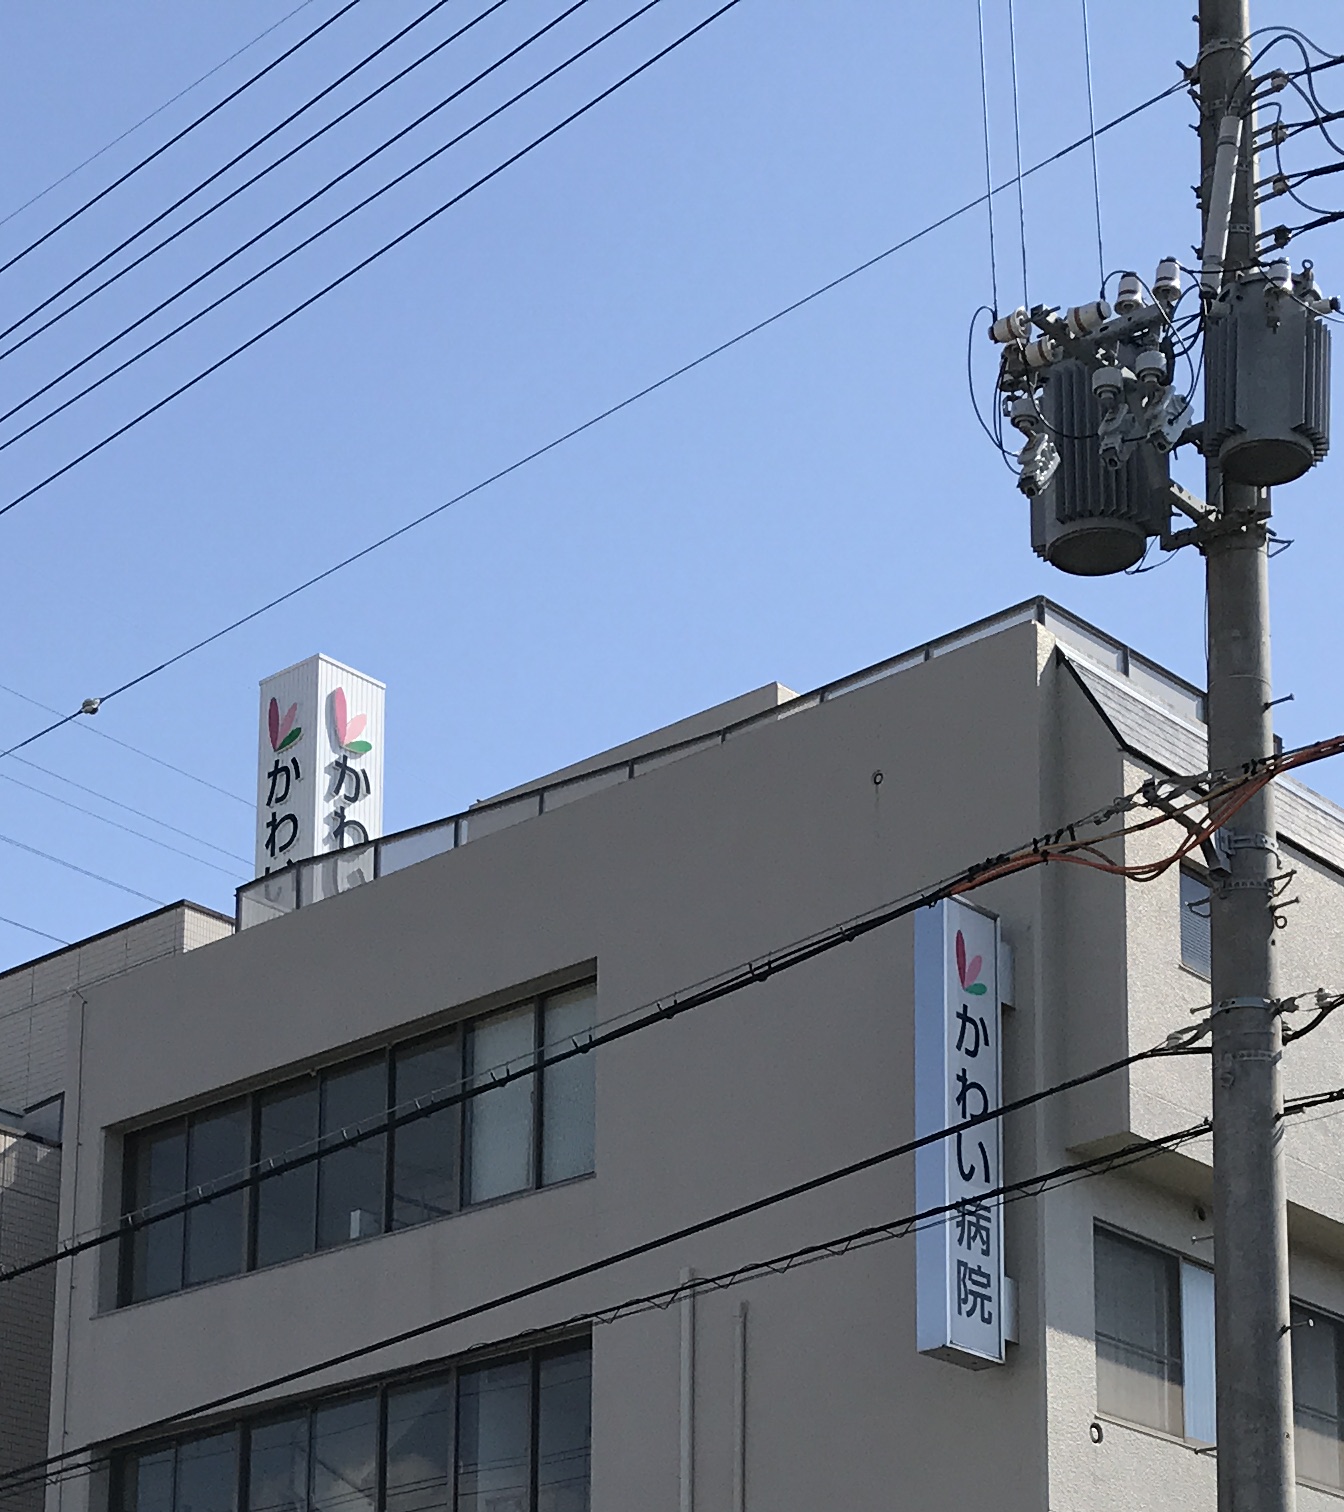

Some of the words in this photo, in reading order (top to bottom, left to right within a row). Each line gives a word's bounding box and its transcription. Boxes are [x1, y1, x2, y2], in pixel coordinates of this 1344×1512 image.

[955, 1003, 993, 1326] かわい病院
